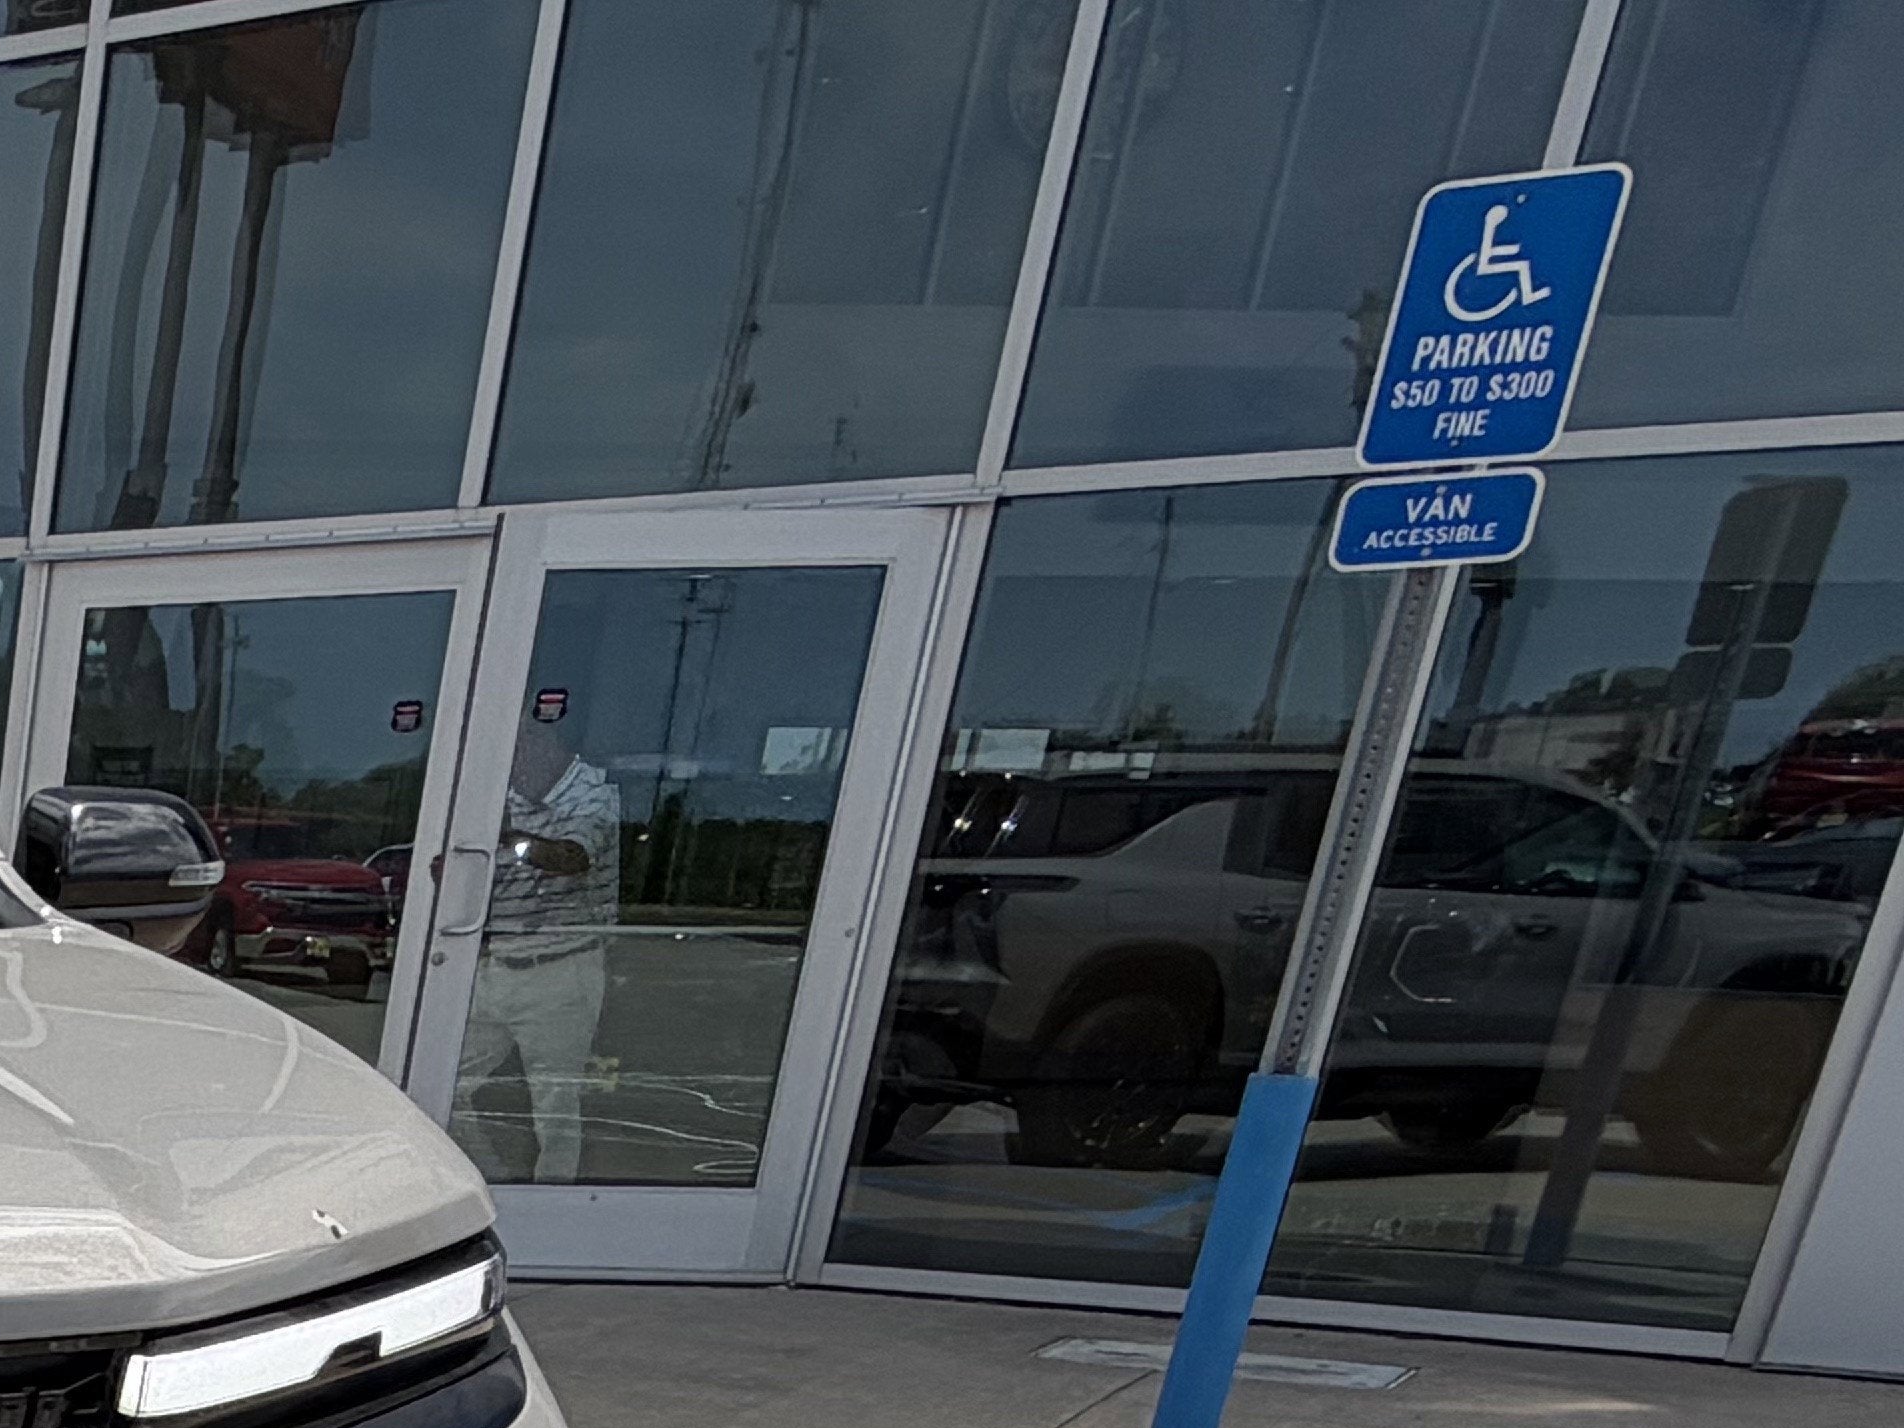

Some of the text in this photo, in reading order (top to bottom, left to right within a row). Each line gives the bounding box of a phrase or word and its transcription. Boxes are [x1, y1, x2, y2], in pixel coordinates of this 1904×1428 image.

[1411, 325, 1554, 372] PARKING
[1391, 368, 1555, 410] $50 TO $300
[1432, 408, 1491, 440] FINE
[1406, 494, 1473, 524] VAN
[1362, 522, 1499, 550] ACCESSIBLE
